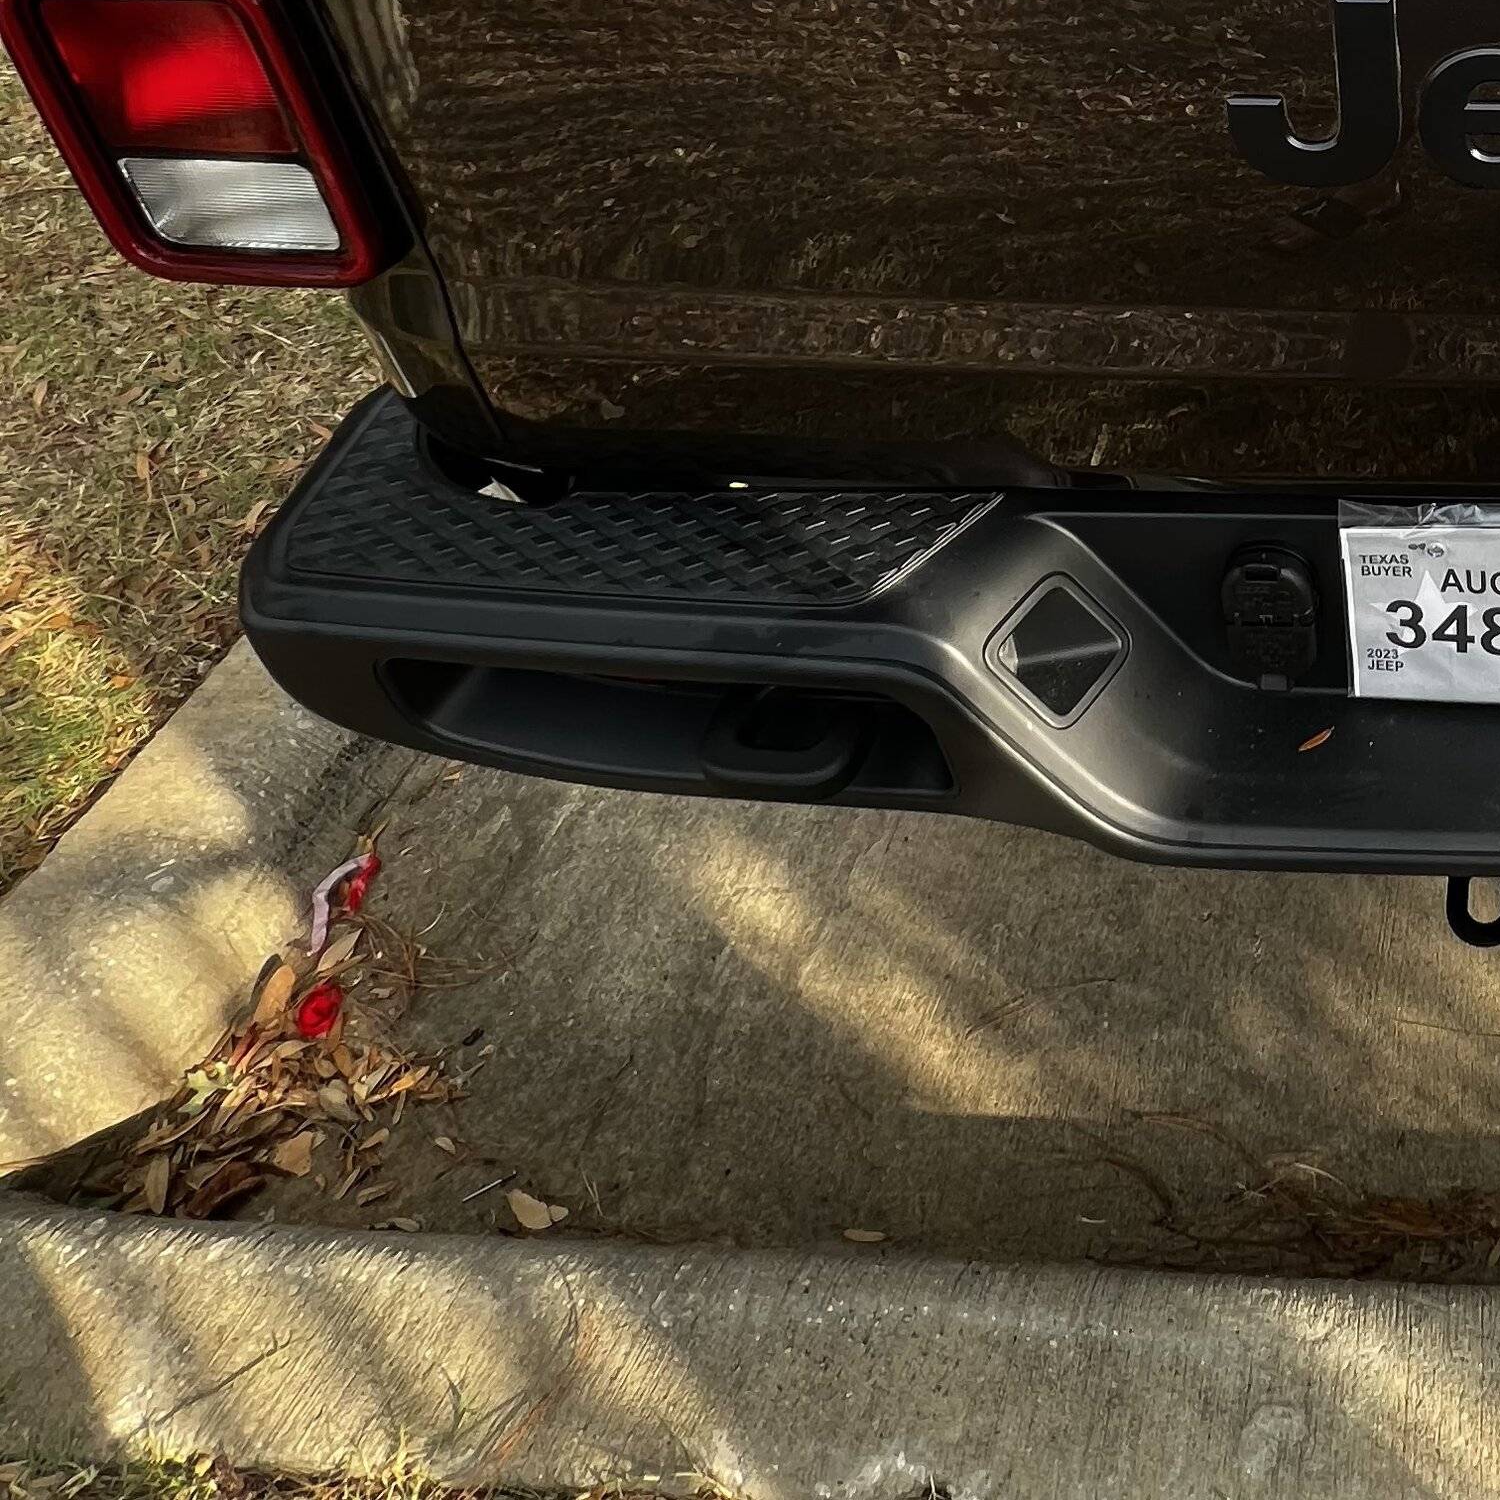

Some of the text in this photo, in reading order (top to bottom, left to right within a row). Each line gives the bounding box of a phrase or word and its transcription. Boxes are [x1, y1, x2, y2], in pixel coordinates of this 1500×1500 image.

[1359, 554, 1409, 565] TEXAS
[1361, 566, 1412, 577] BUYER
[1366, 648, 1399, 660] 2023
[1367, 659, 1404, 672] JEEP
